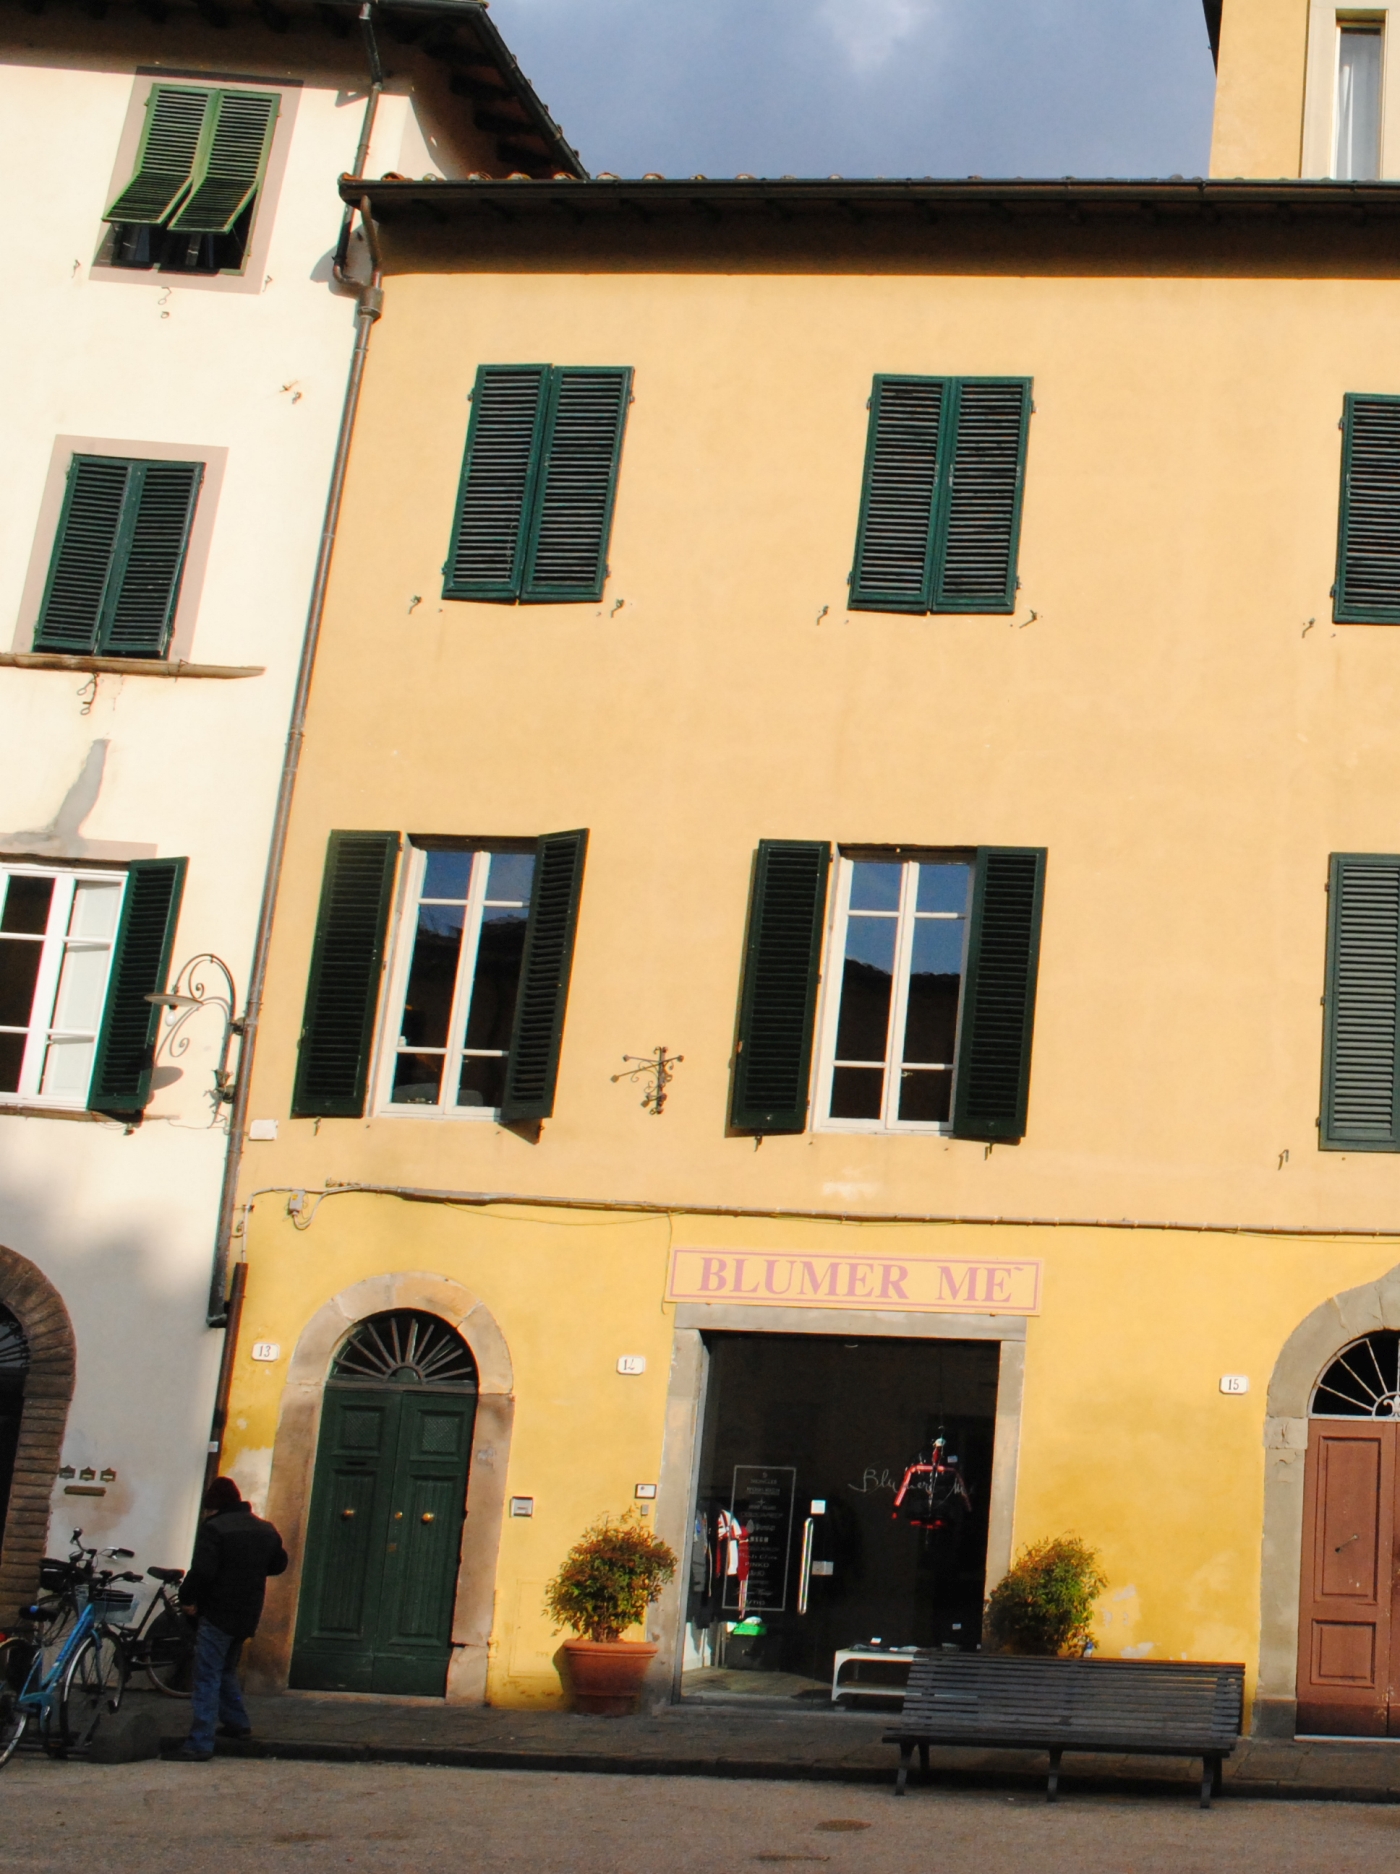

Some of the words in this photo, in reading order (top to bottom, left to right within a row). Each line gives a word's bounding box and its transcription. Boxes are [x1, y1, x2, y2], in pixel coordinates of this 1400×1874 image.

[696, 1257, 910, 1299] BLUMER
[259, 1345, 271, 1358] 13
[1228, 1379, 1240, 1391] 15
